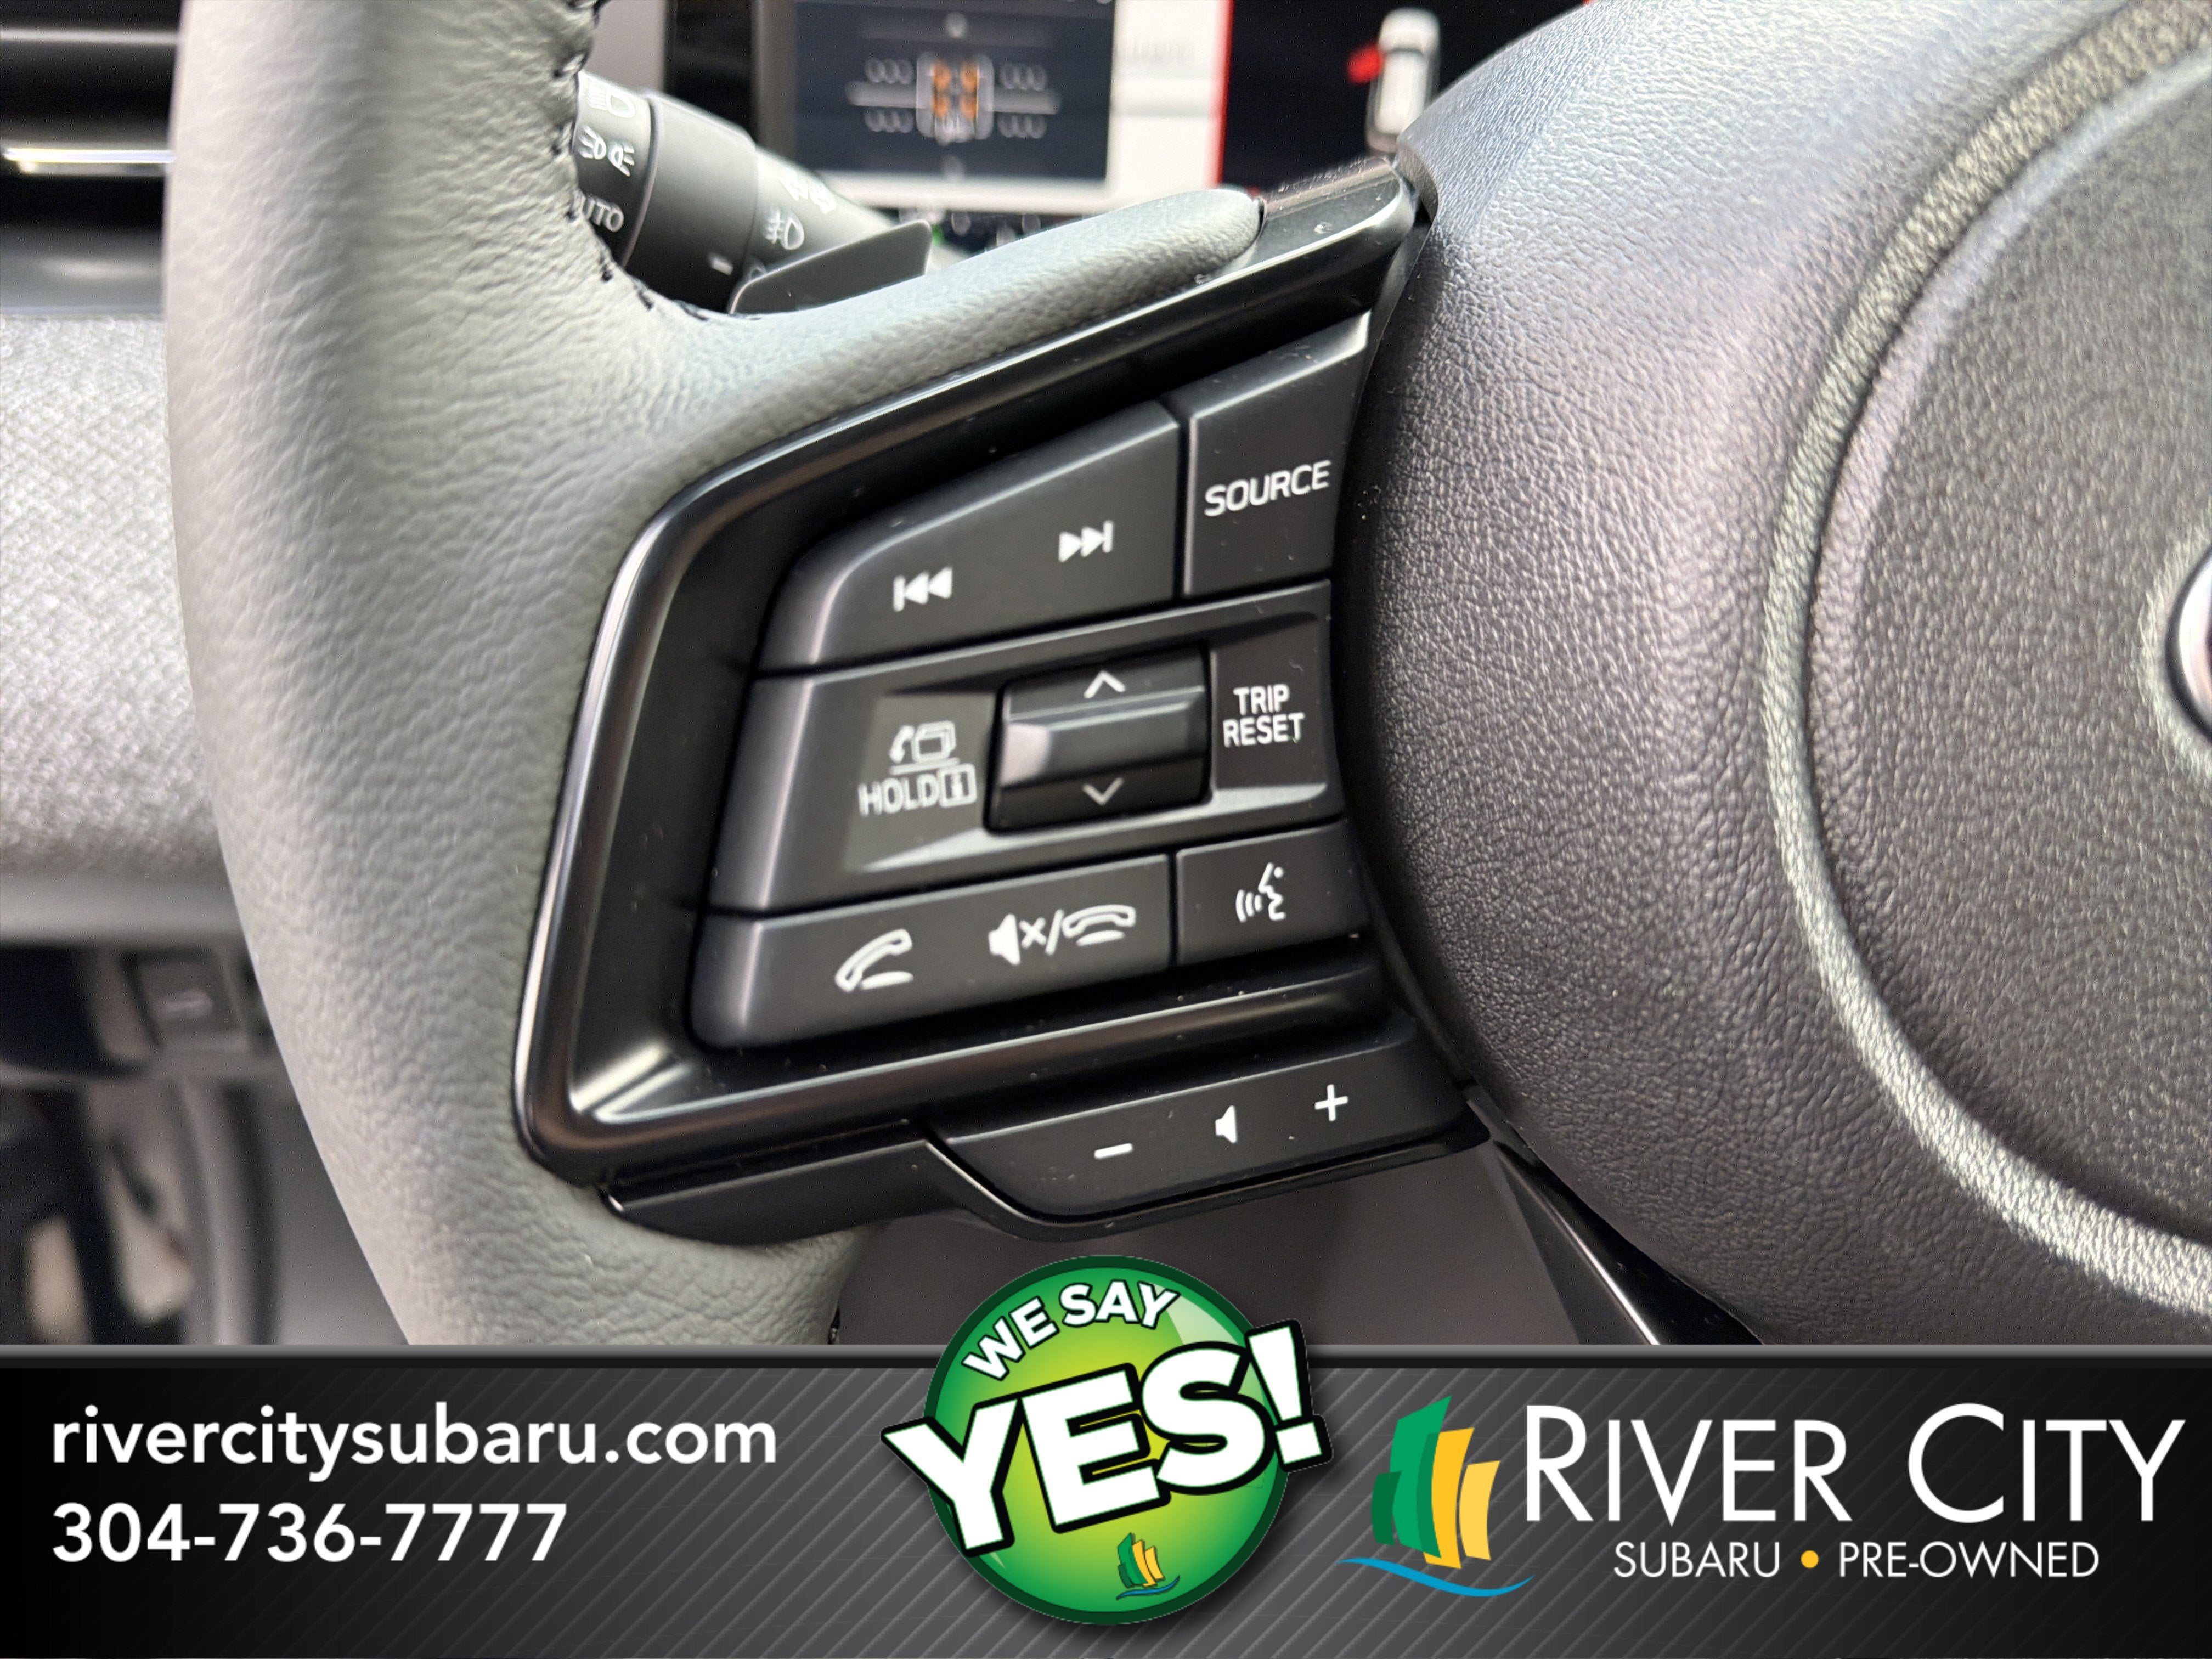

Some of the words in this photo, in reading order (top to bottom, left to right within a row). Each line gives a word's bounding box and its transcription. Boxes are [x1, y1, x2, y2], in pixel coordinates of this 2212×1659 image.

[1204, 459, 1331, 517] SOURCE
[1233, 683, 1290, 715] TRIP
[1222, 712, 1306, 748] RESET
[857, 772, 939, 816] HOLD
